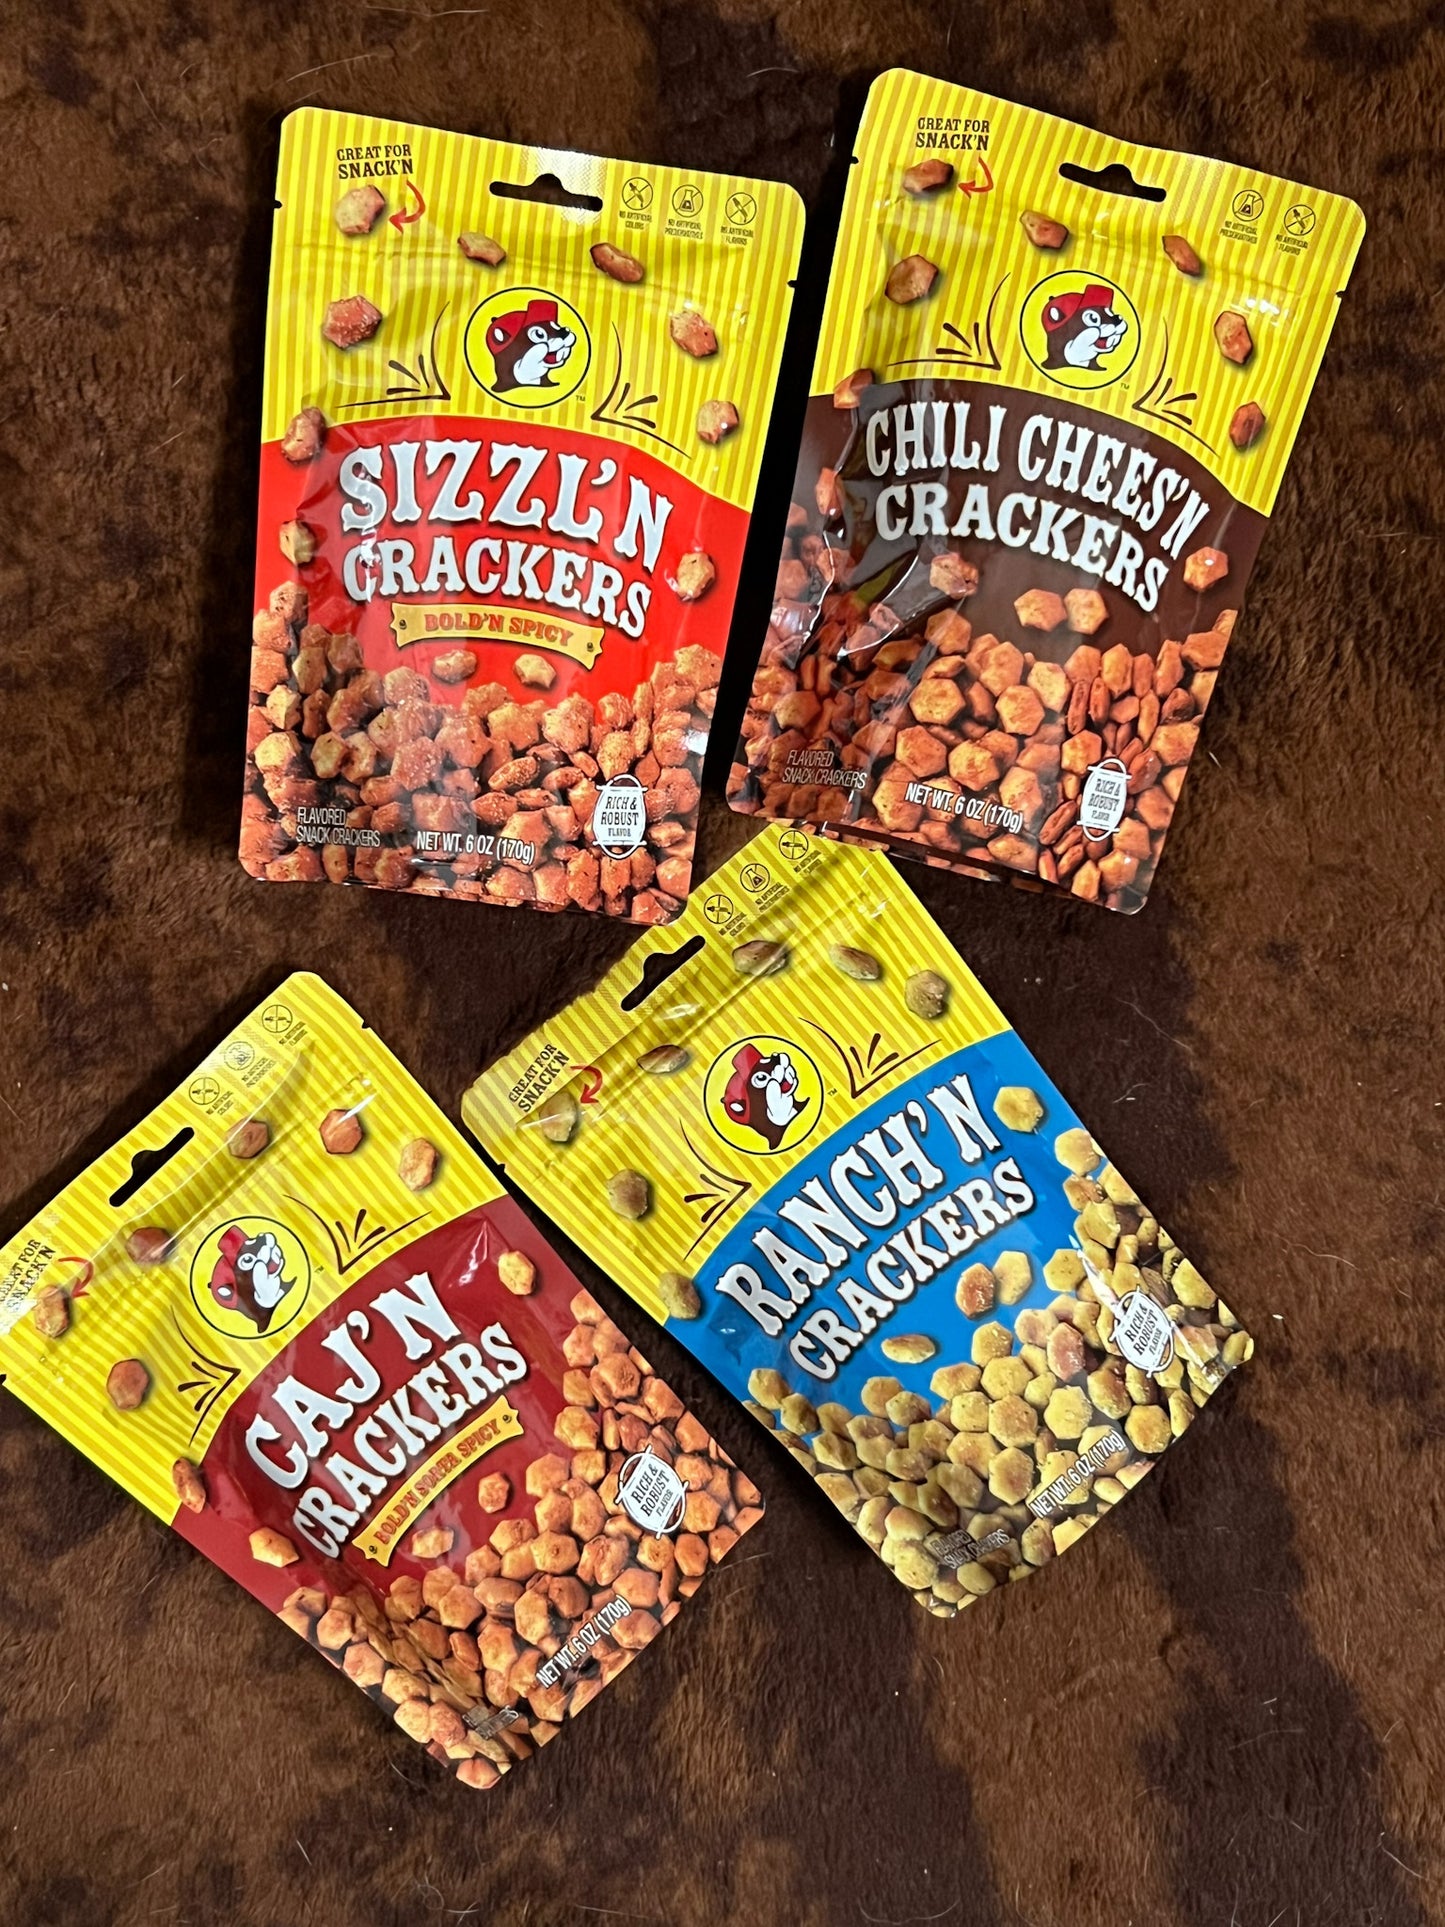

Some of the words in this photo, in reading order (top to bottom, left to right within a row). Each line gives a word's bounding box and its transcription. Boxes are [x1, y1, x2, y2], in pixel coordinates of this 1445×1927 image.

[915, 132, 989, 151] SNACK'N
[918, 117, 961, 131] GREAT
[964, 119, 990, 133] FOR
[336, 146, 381, 161] GREAT
[384, 144, 411, 157] FOR
[338, 159, 413, 179] SNACK'N
[865, 400, 1007, 477] CHILI
[1017, 413, 1210, 560] CHEES'N
[339, 438, 674, 573] SIZZL'N
[875, 481, 1169, 612] CRACKERS
[343, 535, 651, 638] CRACKERS
[424, 612, 504, 632] BOLD'N
[509, 617, 573, 646] SPICY
[782, 767, 814, 784] SNACK
[815, 769, 868, 789] CRACKERS
[786, 749, 834, 767] FLAVORED
[297, 806, 346, 826] FLAVORED
[601, 812, 639, 825] ROBUST
[605, 796, 630, 809] RICH
[630, 797, 637, 810] &
[905, 782, 932, 806] NET
[931, 789, 953, 812] WT.
[955, 796, 965, 814] 6
[966, 798, 985, 819] OZ
[984, 803, 1023, 834] (170g)
[296, 825, 330, 843] SNACK
[332, 828, 380, 847] CRACKERS
[416, 831, 440, 851] NET
[442, 833, 462, 852] WT.
[465, 834, 474, 853] 6
[477, 835, 495, 855] OZ
[496, 837, 535, 865] (170g)
[508, 1064, 538, 1102] GREAT
[534, 1044, 557, 1068] FOR
[518, 1051, 570, 1112] SNACK'N
[715, 1073, 1001, 1336] RANCH'N
[18, 1239, 41, 1262] FOR
[789, 1156, 1034, 1380] CRACKERS
[1124, 1310, 1145, 1342] RICH
[1139, 1303, 1148, 1315] &
[1133, 1309, 1158, 1355] ROBUST
[245, 1271, 461, 1489] CAJ'N
[293, 1322, 527, 1558] CRACKERS
[373, 1489, 420, 1544] BOLD'N
[456, 1418, 501, 1459] SPICY
[631, 1471, 653, 1503] RICH
[648, 1463, 658, 1476] &
[640, 1470, 670, 1517] ROBUST
[1029, 1490, 1056, 1518] NET
[1067, 1469, 1081, 1484] 6
[1075, 1454, 1095, 1477] OZ
[1089, 1429, 1126, 1467] (170g)
[656, 1489, 673, 1517] FLAVOR
[536, 1659, 561, 1688] NET
[554, 1644, 579, 1670] WT.
[572, 1637, 587, 1653] 6
[580, 1622, 601, 1646] OZ
[594, 1594, 632, 1635] (170g)
